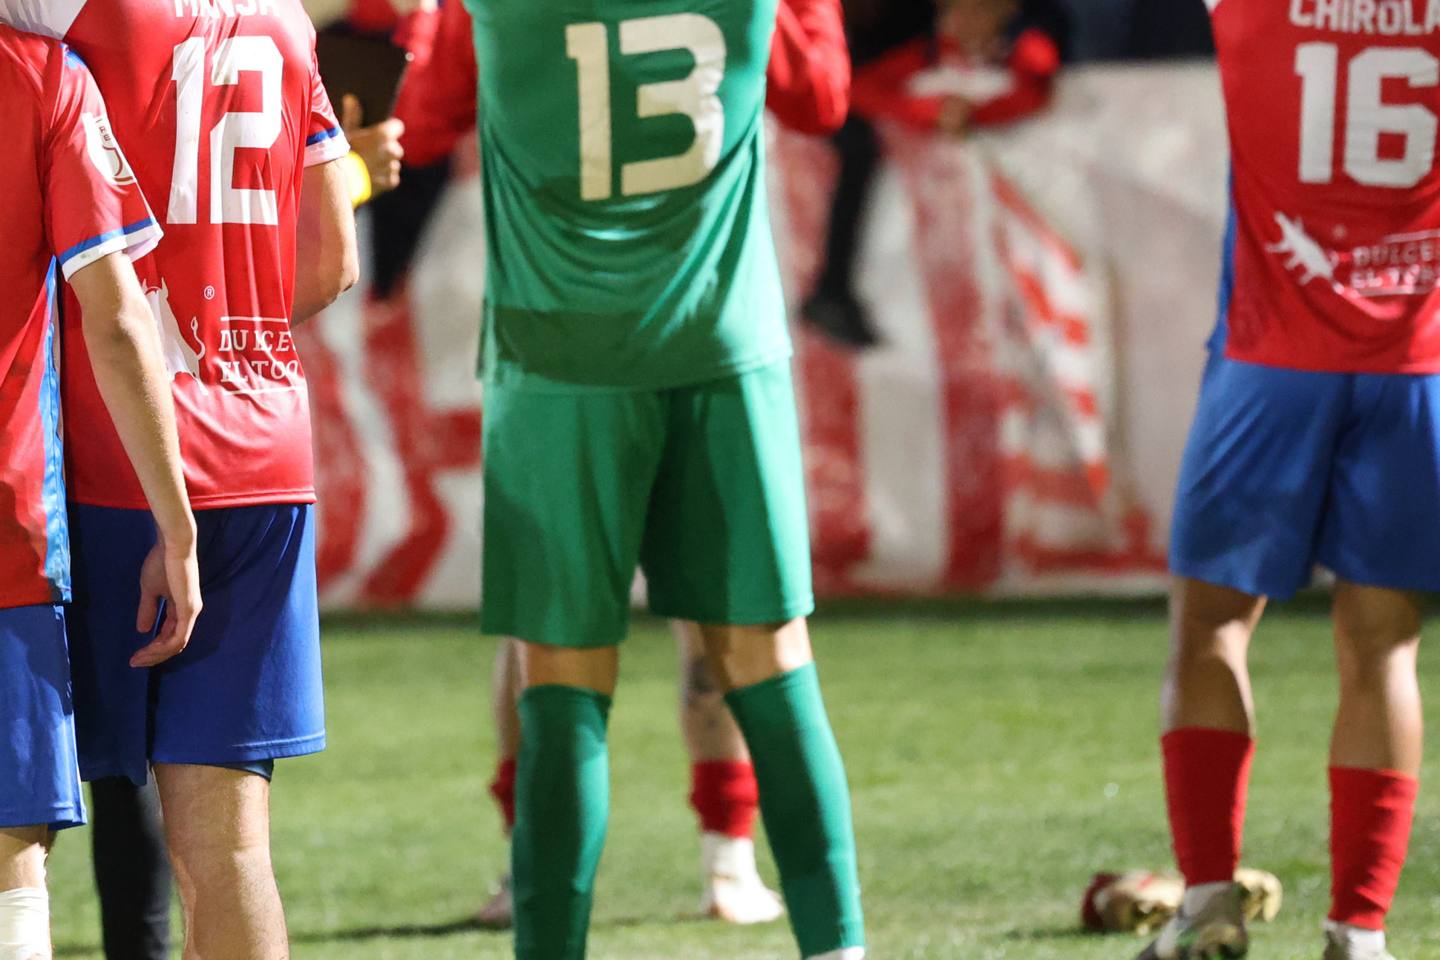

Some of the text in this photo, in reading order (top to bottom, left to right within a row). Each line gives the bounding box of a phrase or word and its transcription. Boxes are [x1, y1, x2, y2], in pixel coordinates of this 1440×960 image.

[166, 36, 285, 226] 12
[566, 13, 726, 202] 13
[1295, 41, 1439, 188] 16
[219, 328, 296, 351] DULCE
